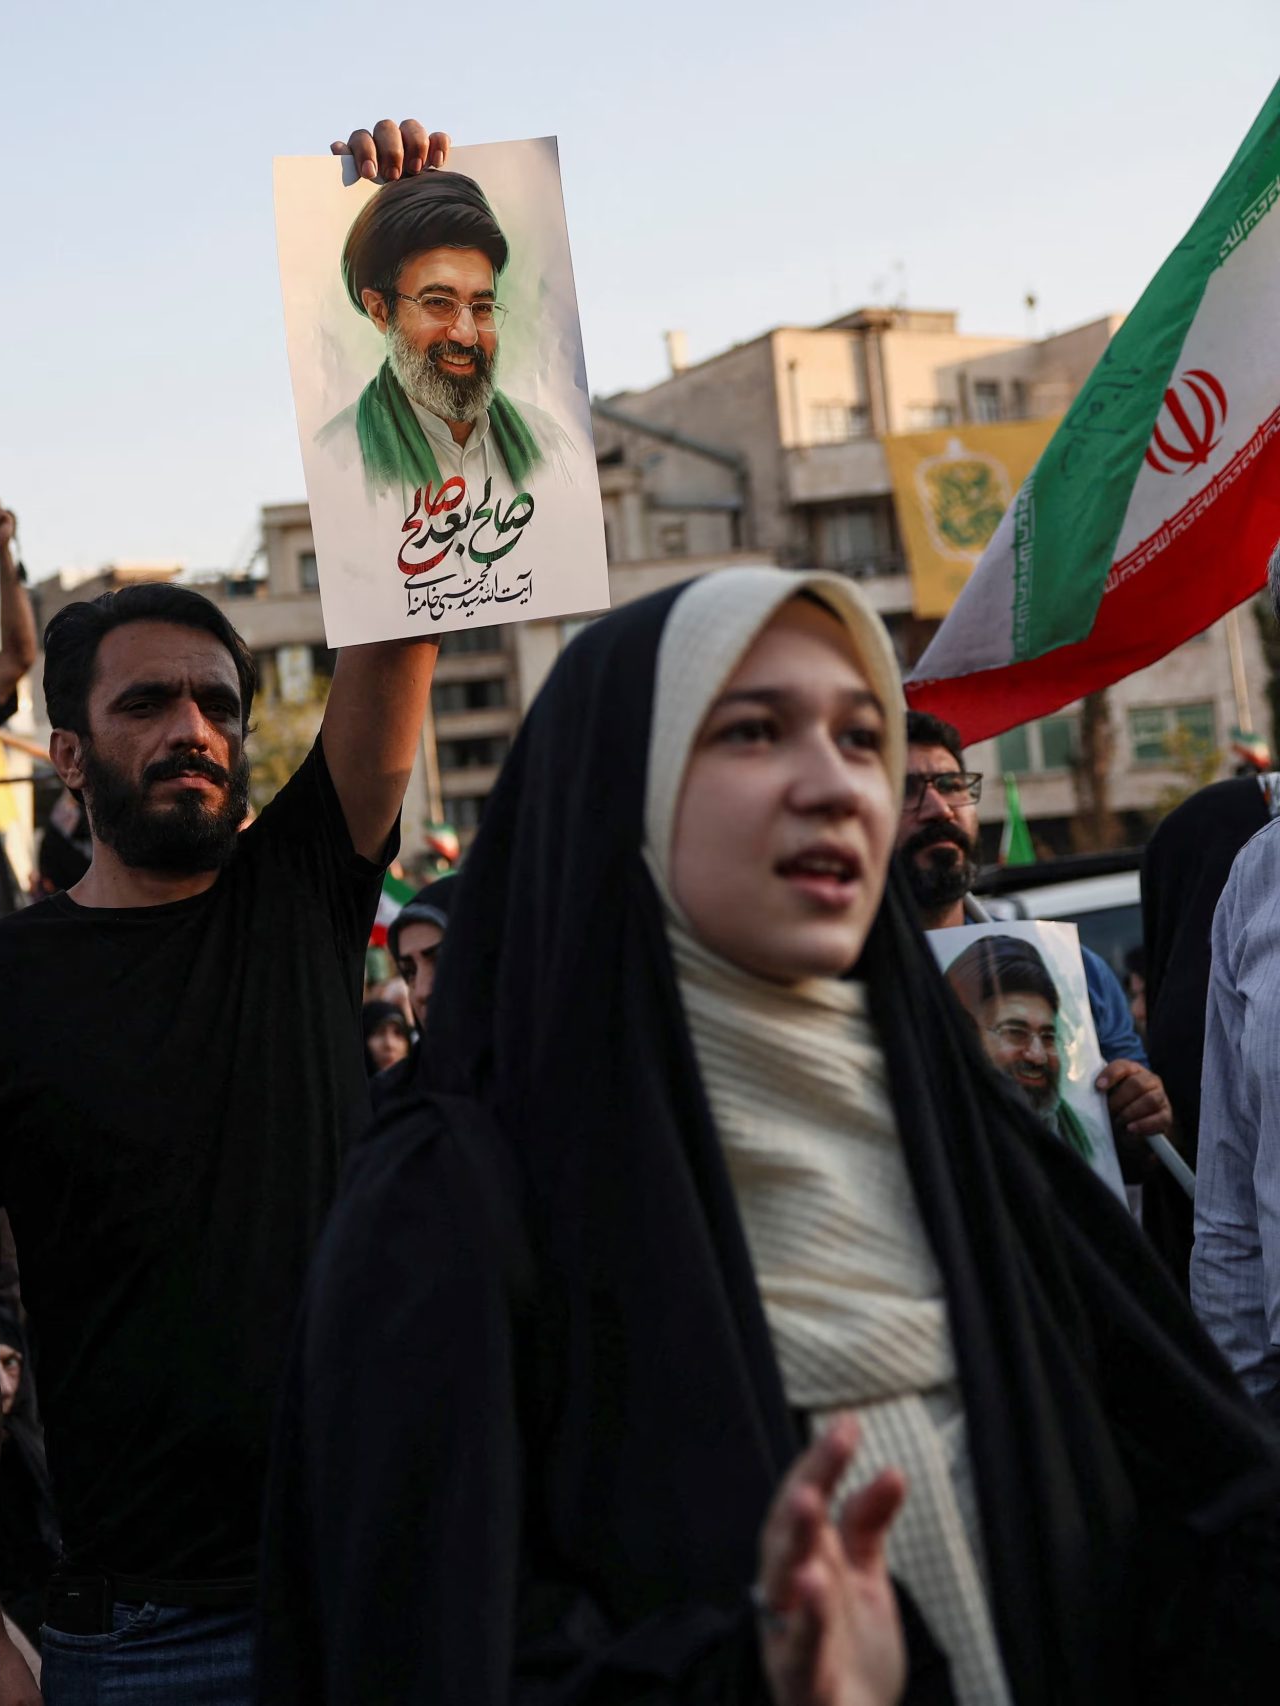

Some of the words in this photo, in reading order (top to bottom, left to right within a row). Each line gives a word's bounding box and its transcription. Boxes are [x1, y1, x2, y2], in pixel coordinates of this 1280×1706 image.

[397, 475, 466, 575] صالح
[411, 500, 472, 557] بعد
[468, 476, 535, 564] صالح
[429, 563, 493, 621] مجتبی
